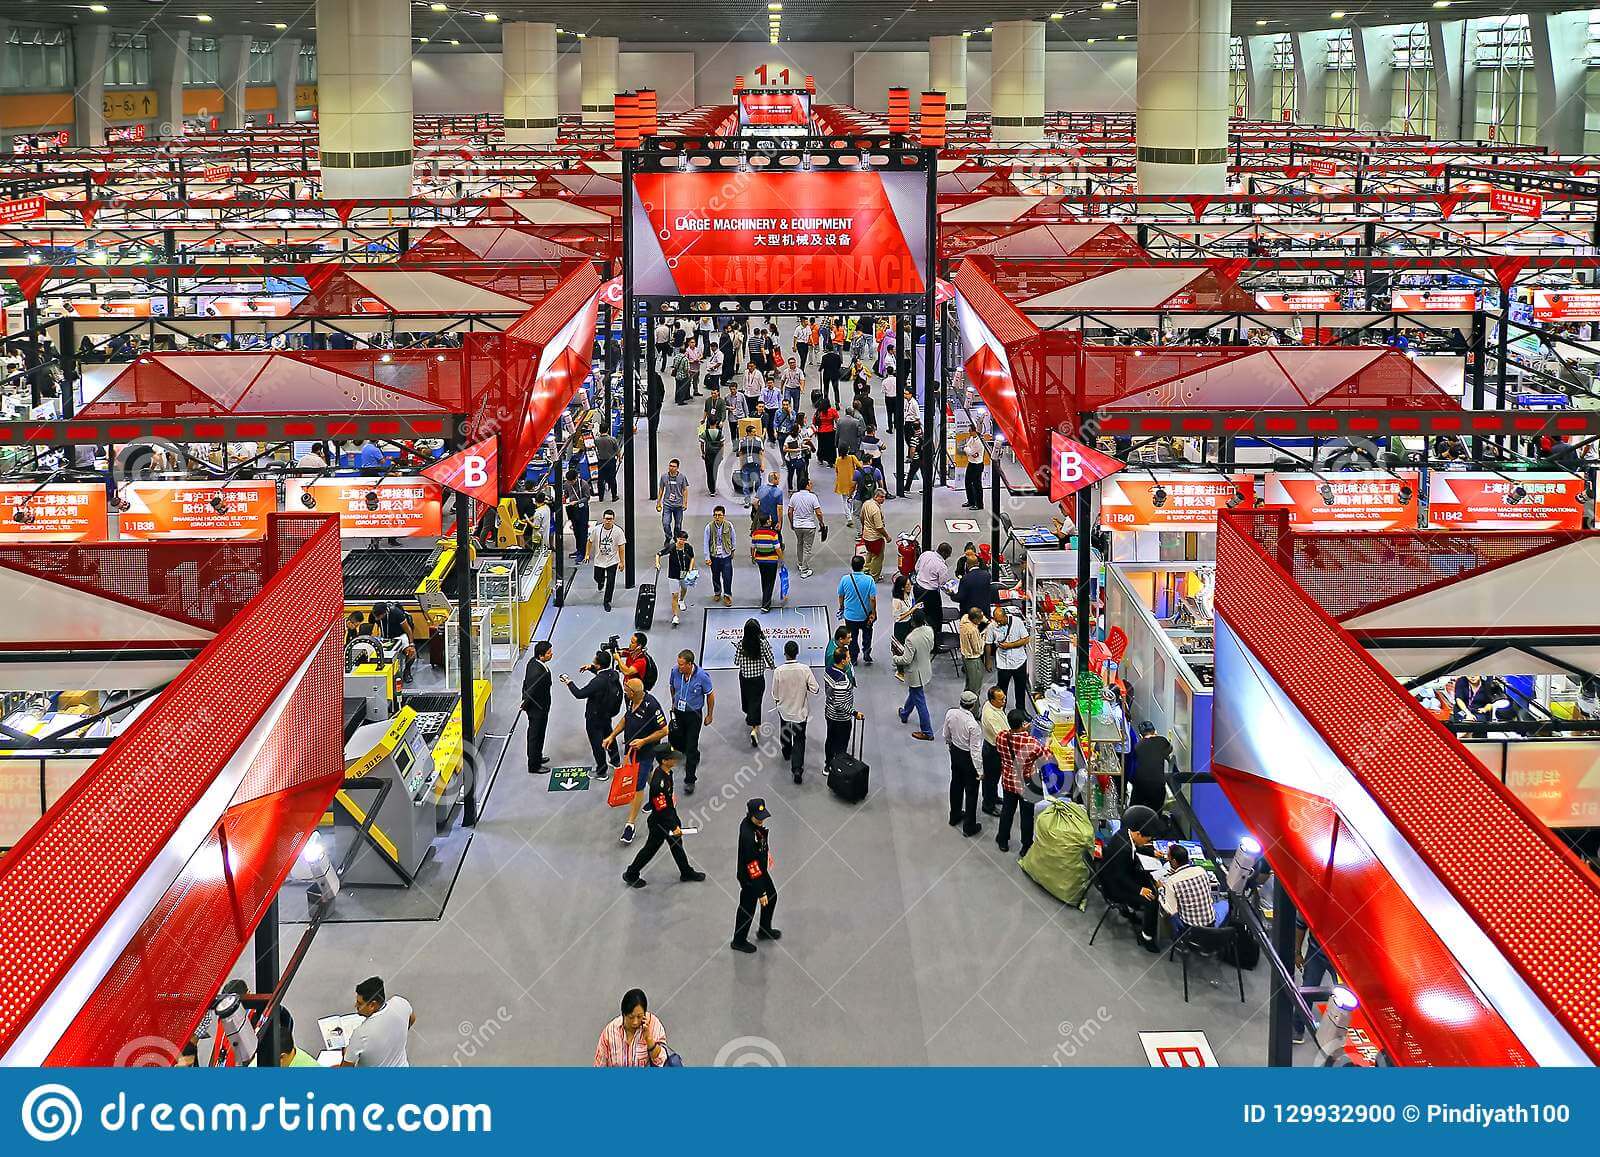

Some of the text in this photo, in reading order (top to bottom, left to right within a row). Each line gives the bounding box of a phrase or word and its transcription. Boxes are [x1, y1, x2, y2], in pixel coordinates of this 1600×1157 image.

[754, 64, 789, 86] 1.1
[136, 127, 143, 137] H
[60, 132, 68, 144] G
[675, 218, 853, 231] LARGE MACHINERY & EQUIPMENT
[753, 233, 851, 247] 大型机械及设备
[704, 255, 813, 295] LARGE
[607, 283, 623, 301] C
[463, 455, 487, 488] B
[1060, 451, 1083, 482] B
[1153, 485, 1236, 495] 昌县新进出口
[1481, 483, 1566, 494] 上海机国际贸易
[1173, 497, 1216, 507] 有限公司
[1503, 494, 1545, 505] 有公司
[182, 503, 248, 513] 股份有公司
[1105, 514, 1135, 523] 1.1B40
[1433, 512, 1463, 521] 1.1B42
[717, 627, 811, 636] 大型及设备
